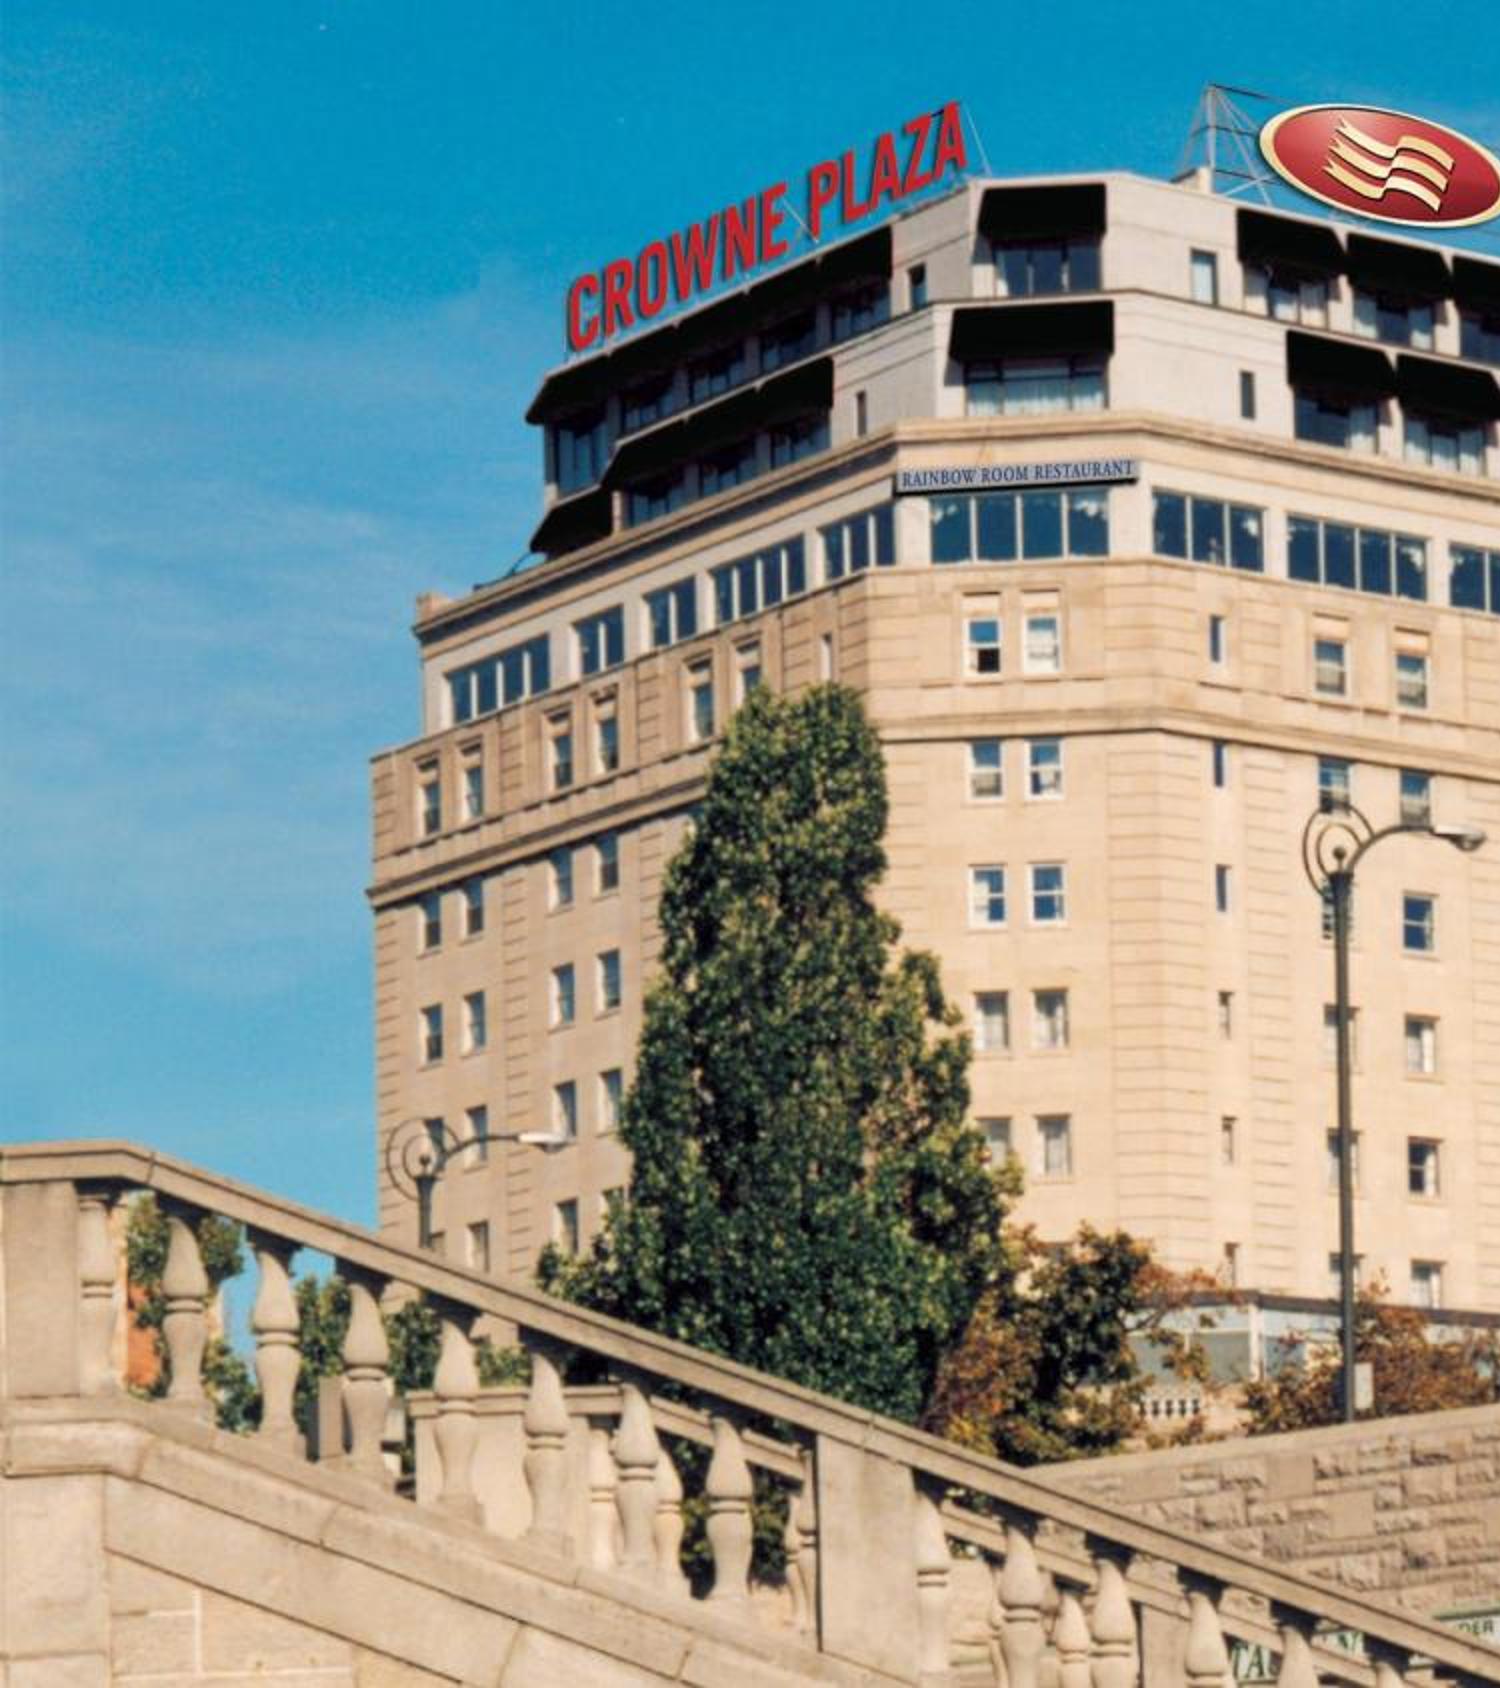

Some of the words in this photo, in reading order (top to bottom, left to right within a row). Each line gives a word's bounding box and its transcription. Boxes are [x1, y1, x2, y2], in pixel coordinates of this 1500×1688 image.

[569, 182, 789, 351] CROWNE
[808, 101, 967, 239] PLAZA
[902, 468, 976, 487] RAINBOW
[981, 465, 1030, 483] ROOM
[1035, 460, 1134, 480] RESTAURANT
